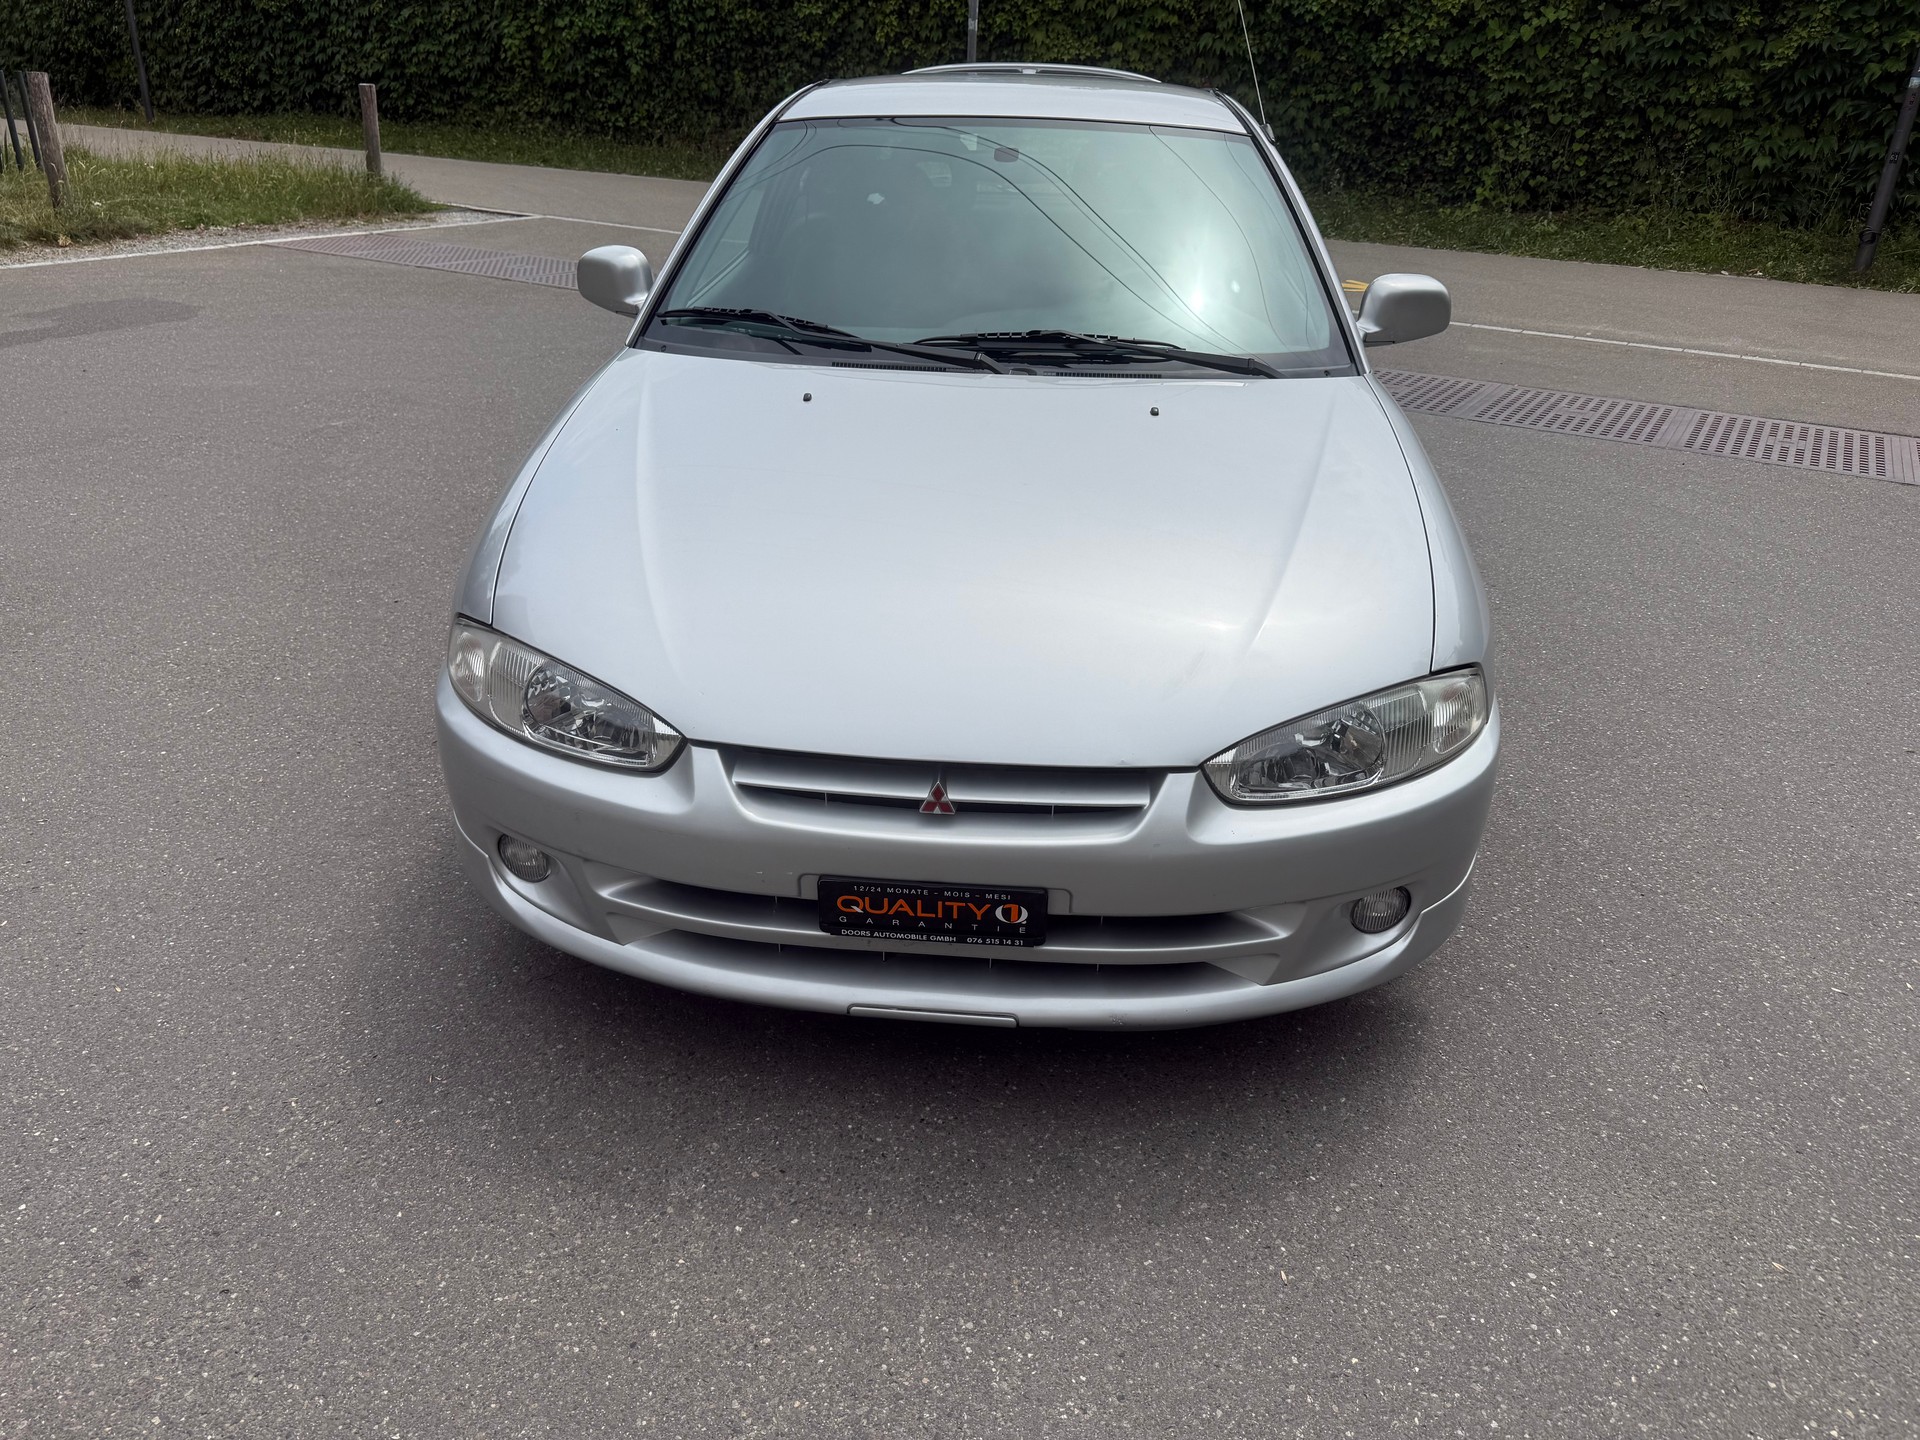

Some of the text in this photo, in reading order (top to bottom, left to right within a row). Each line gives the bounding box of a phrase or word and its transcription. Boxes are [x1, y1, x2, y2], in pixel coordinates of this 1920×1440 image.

[853, 885, 881, 893] 12/24
[886, 887, 929, 895] MONATE
[836, 895, 991, 921] QUALITY
[838, 916, 1026, 934] GARANTIE
[841, 929, 871, 937] DOORS
[873, 931, 928, 941] AUTOMOBILE
